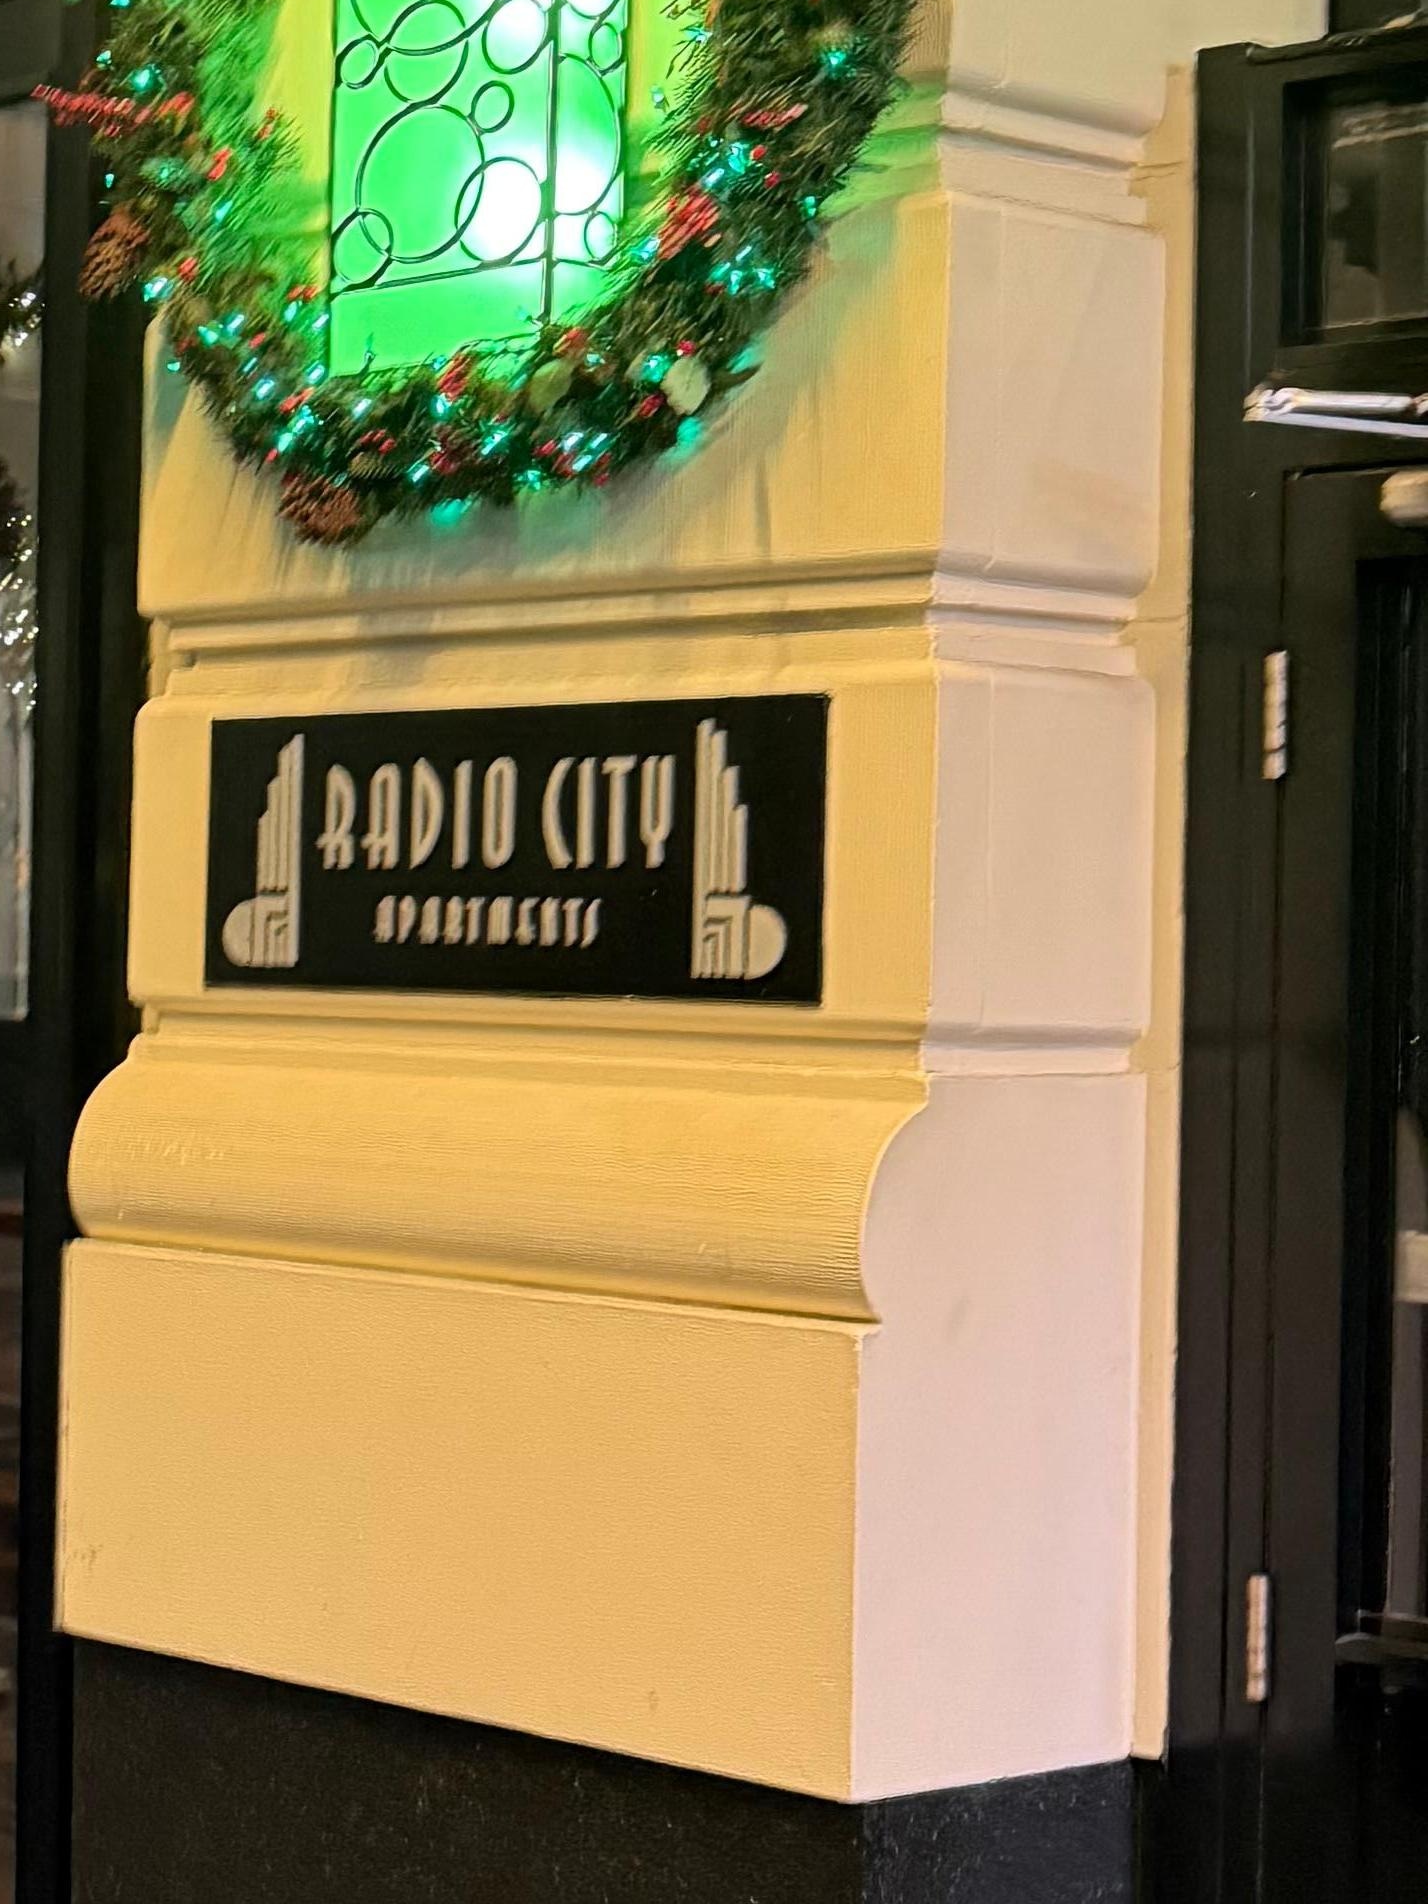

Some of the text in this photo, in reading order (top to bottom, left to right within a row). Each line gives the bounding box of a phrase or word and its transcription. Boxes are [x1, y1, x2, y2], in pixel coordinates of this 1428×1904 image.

[314, 753, 677, 871] RADIO CITY
[371, 894, 602, 950] APARTMENTS
